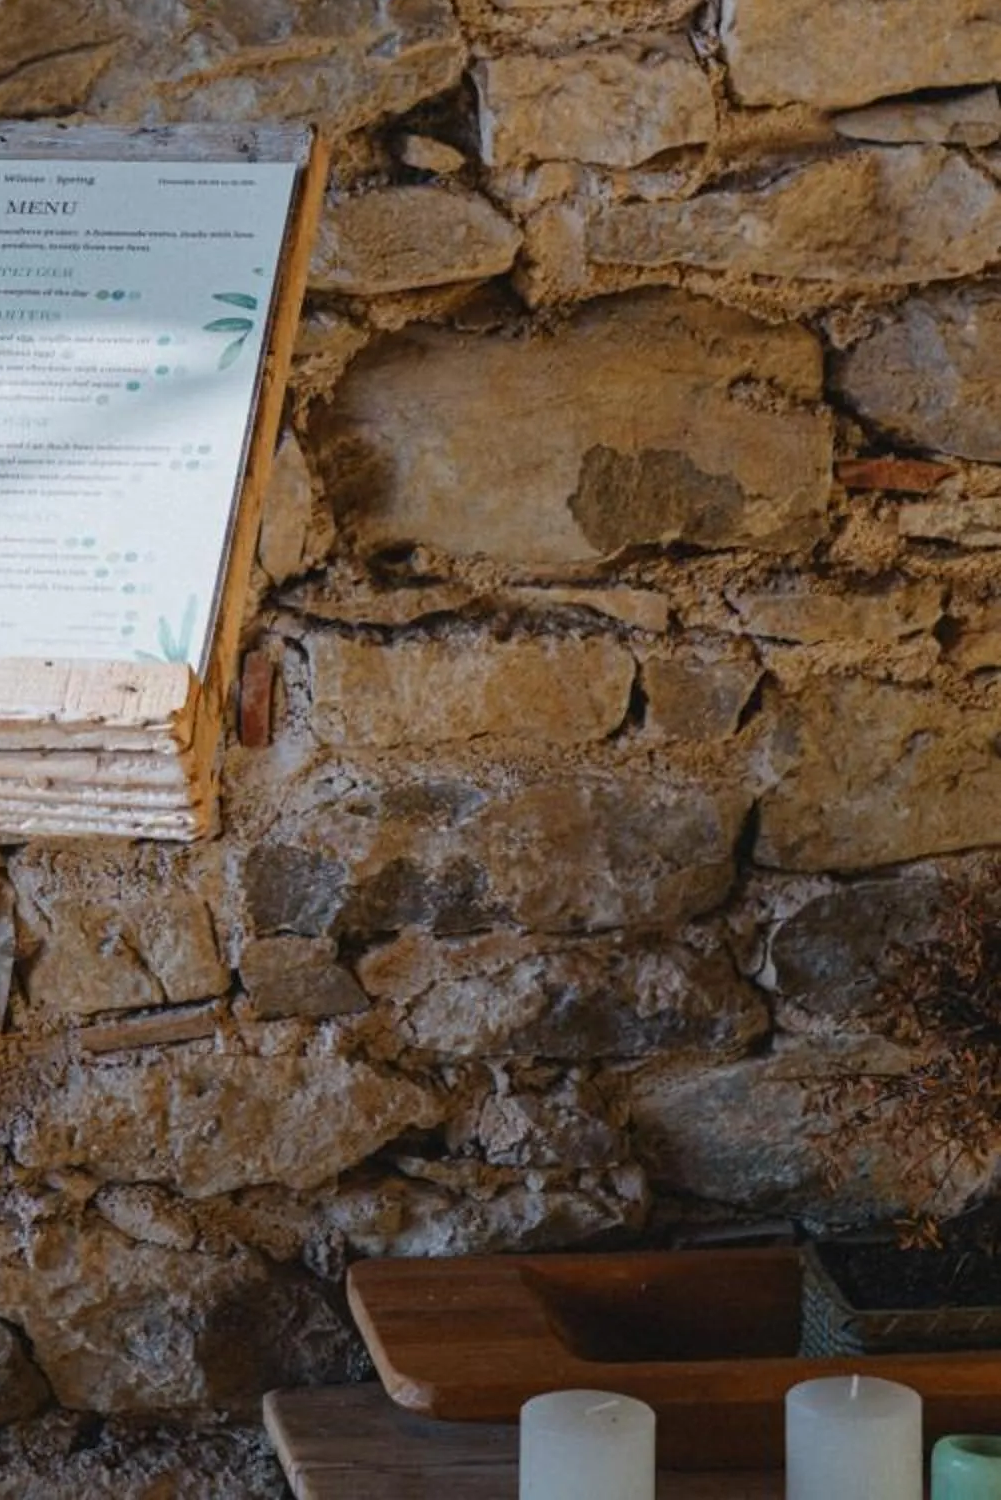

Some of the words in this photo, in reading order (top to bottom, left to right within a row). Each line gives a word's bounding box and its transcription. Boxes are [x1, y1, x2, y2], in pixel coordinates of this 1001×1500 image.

[4, 173, 46, 184] Winter
[56, 175, 95, 186] Spring
[6, 200, 78, 215] MENU
